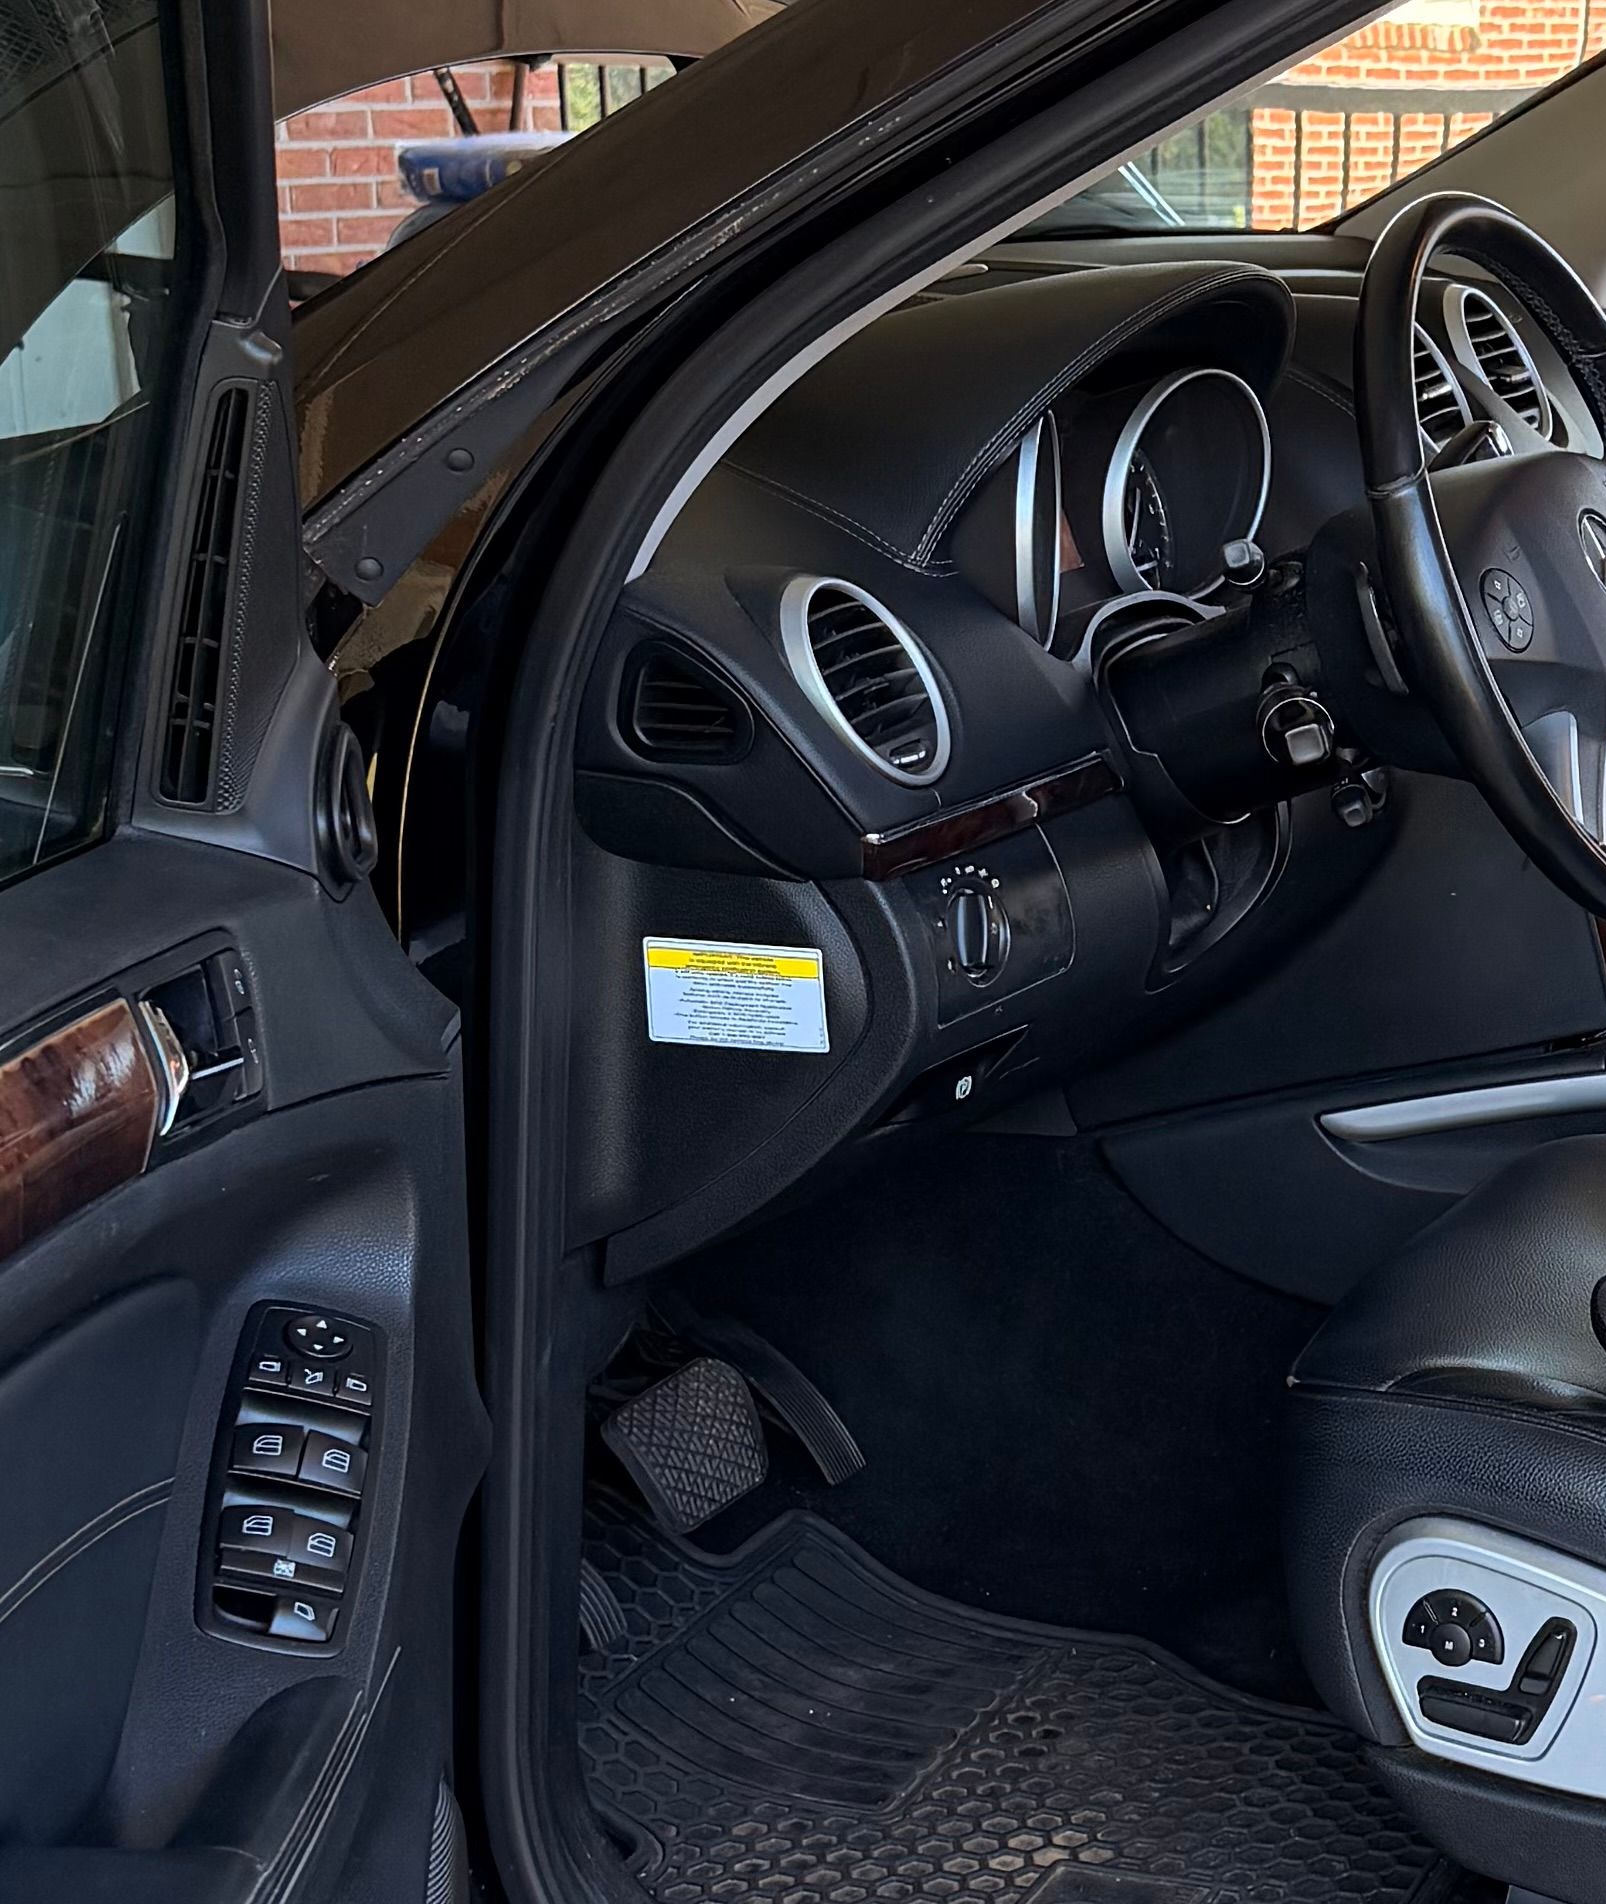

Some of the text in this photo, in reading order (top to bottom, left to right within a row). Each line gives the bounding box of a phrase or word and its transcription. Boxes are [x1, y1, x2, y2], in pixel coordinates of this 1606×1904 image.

[1451, 1607, 1458, 1617] 2
[1420, 1625, 1425, 1634] 1
[1479, 1638, 1485, 1648] 3
